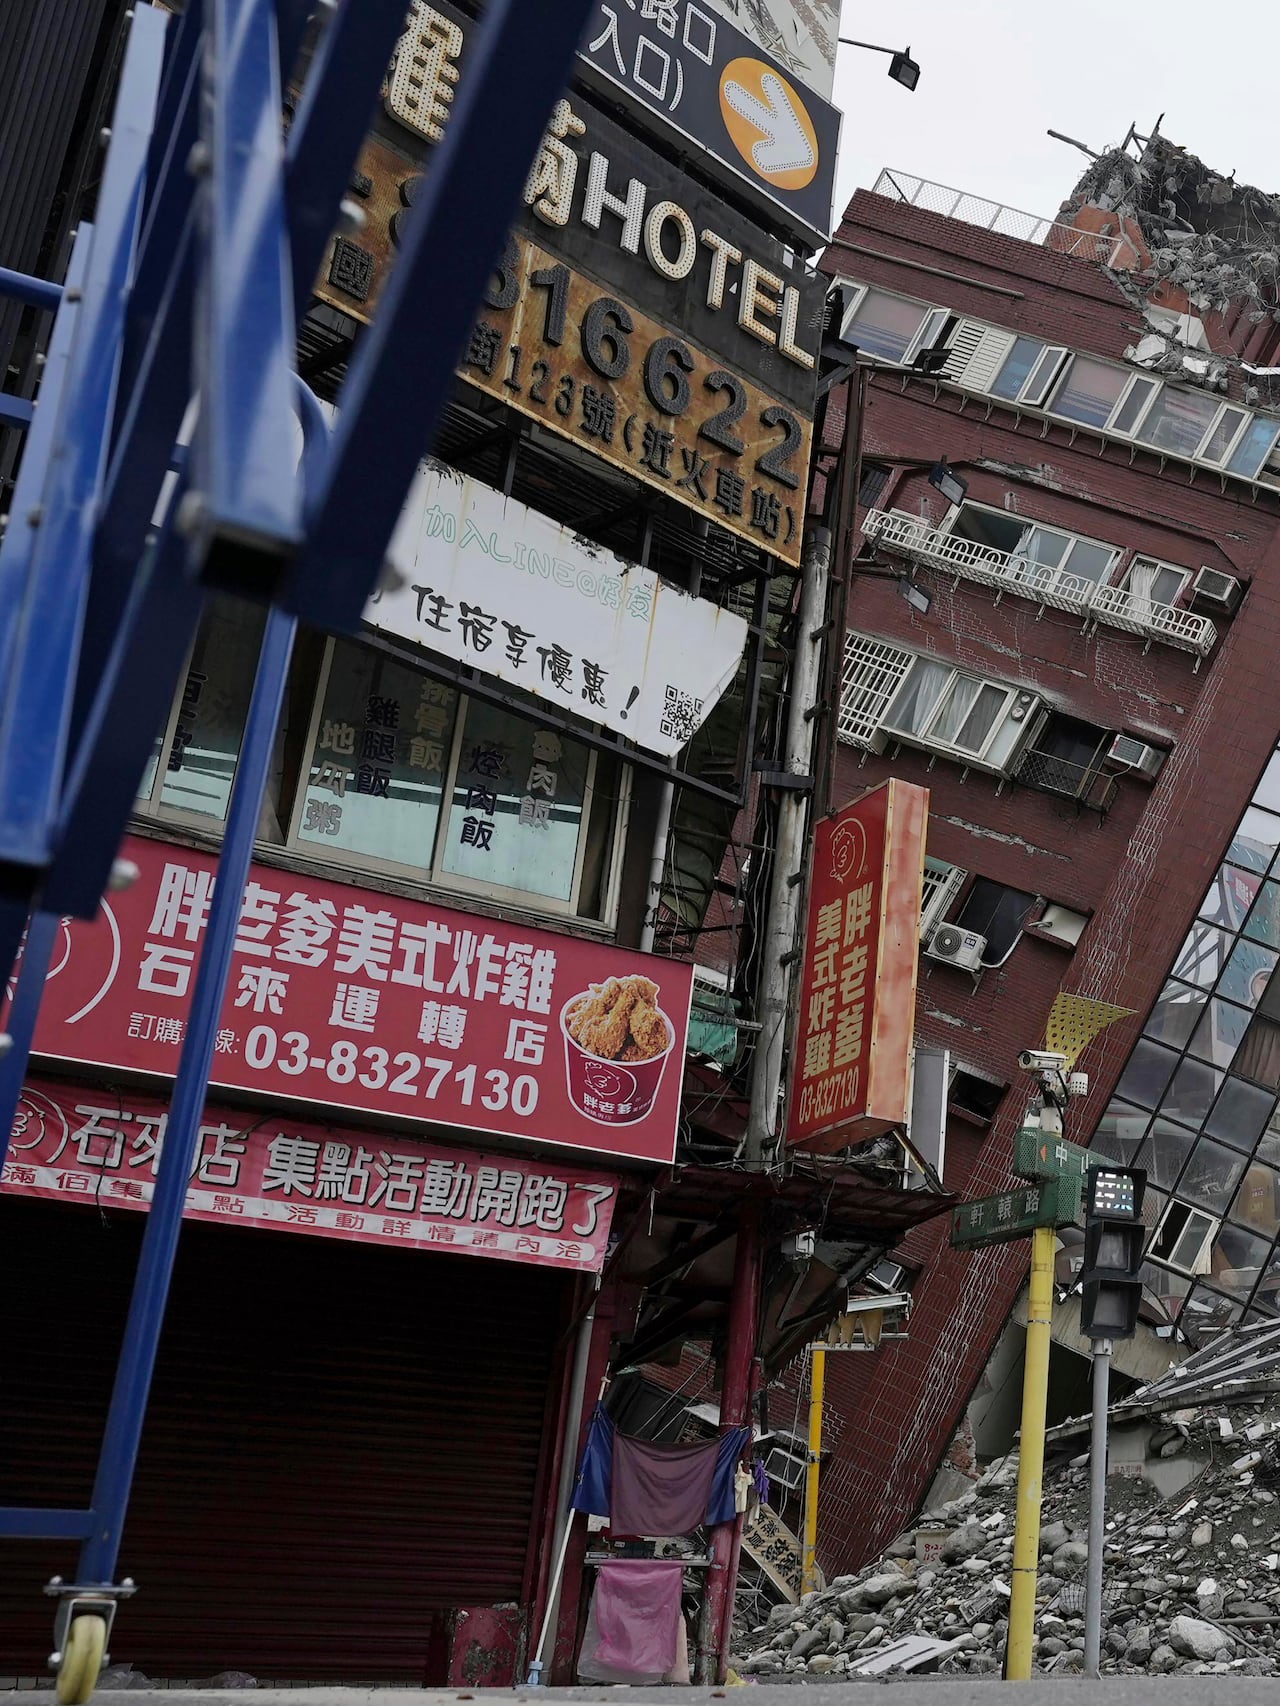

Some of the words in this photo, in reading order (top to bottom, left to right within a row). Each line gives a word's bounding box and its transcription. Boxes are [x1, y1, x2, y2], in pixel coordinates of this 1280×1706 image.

[625, 0, 717, 66] 路口
[580, 150, 816, 370] HOTEL
[425, 504, 651, 622] 加入LINE@好友
[303, 717, 357, 837] 地瓜粥
[517, 729, 563, 832] 肉飯
[148, 862, 558, 1016] 胖老爹美式炸雞
[802, 896, 843, 1081] 美式炸雞
[832, 880, 874, 1070] 胖老爹
[127, 1010, 240, 1056] 訂購線:
[244, 1023, 539, 1117] 03-8327130
[798, 1068, 861, 1126] 03-8327130
[263, 1131, 614, 1237] 集點活動開跑了
[969, 1187, 1040, 1228] 軒轅路
